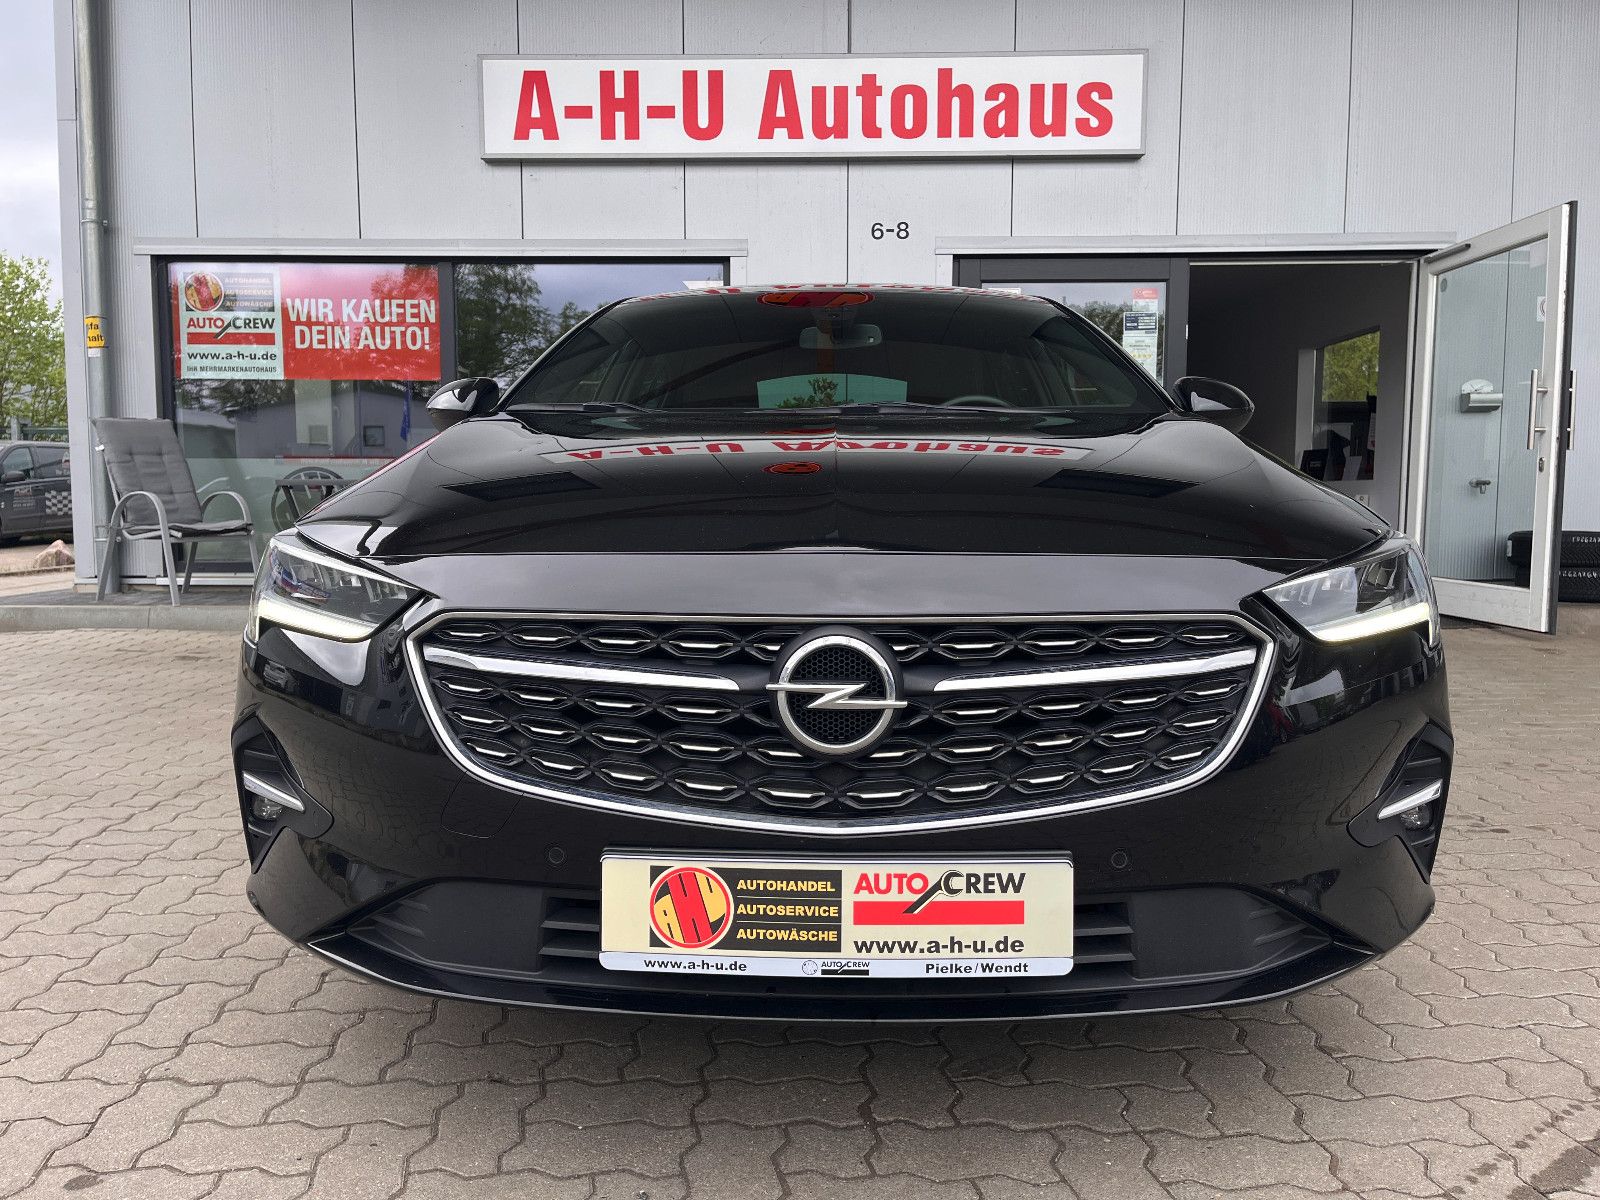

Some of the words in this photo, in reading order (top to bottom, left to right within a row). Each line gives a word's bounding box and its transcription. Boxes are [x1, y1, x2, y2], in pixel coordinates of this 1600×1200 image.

[514, 69, 724, 141] A-H-U
[757, 67, 1114, 141] Autohaus
[871, 221, 910, 240] 6-8
[286, 298, 332, 322] WIR
[342, 298, 436, 323] KAUFEN
[187, 317, 225, 329] AUTO
[232, 316, 276, 329] CREW
[294, 325, 350, 349] DEIN
[358, 327, 431, 350] AUTO!
[187, 351, 277, 361] www.a-h-u.de
[200, 365, 277, 373] MEHRMARKENAUTOHAUS
[737, 879, 836, 892] AUTOHANDEL
[854, 871, 930, 896] AUTO
[941, 869, 1026, 897] CREW
[737, 903, 839, 917] AUTOSERVICE
[737, 927, 838, 942] AUTOWÄSCHE
[853, 935, 1026, 954] www.a-h-u.de
[643, 958, 748, 973] www.a-h-u.de
[821, 961, 843, 969] AUTO
